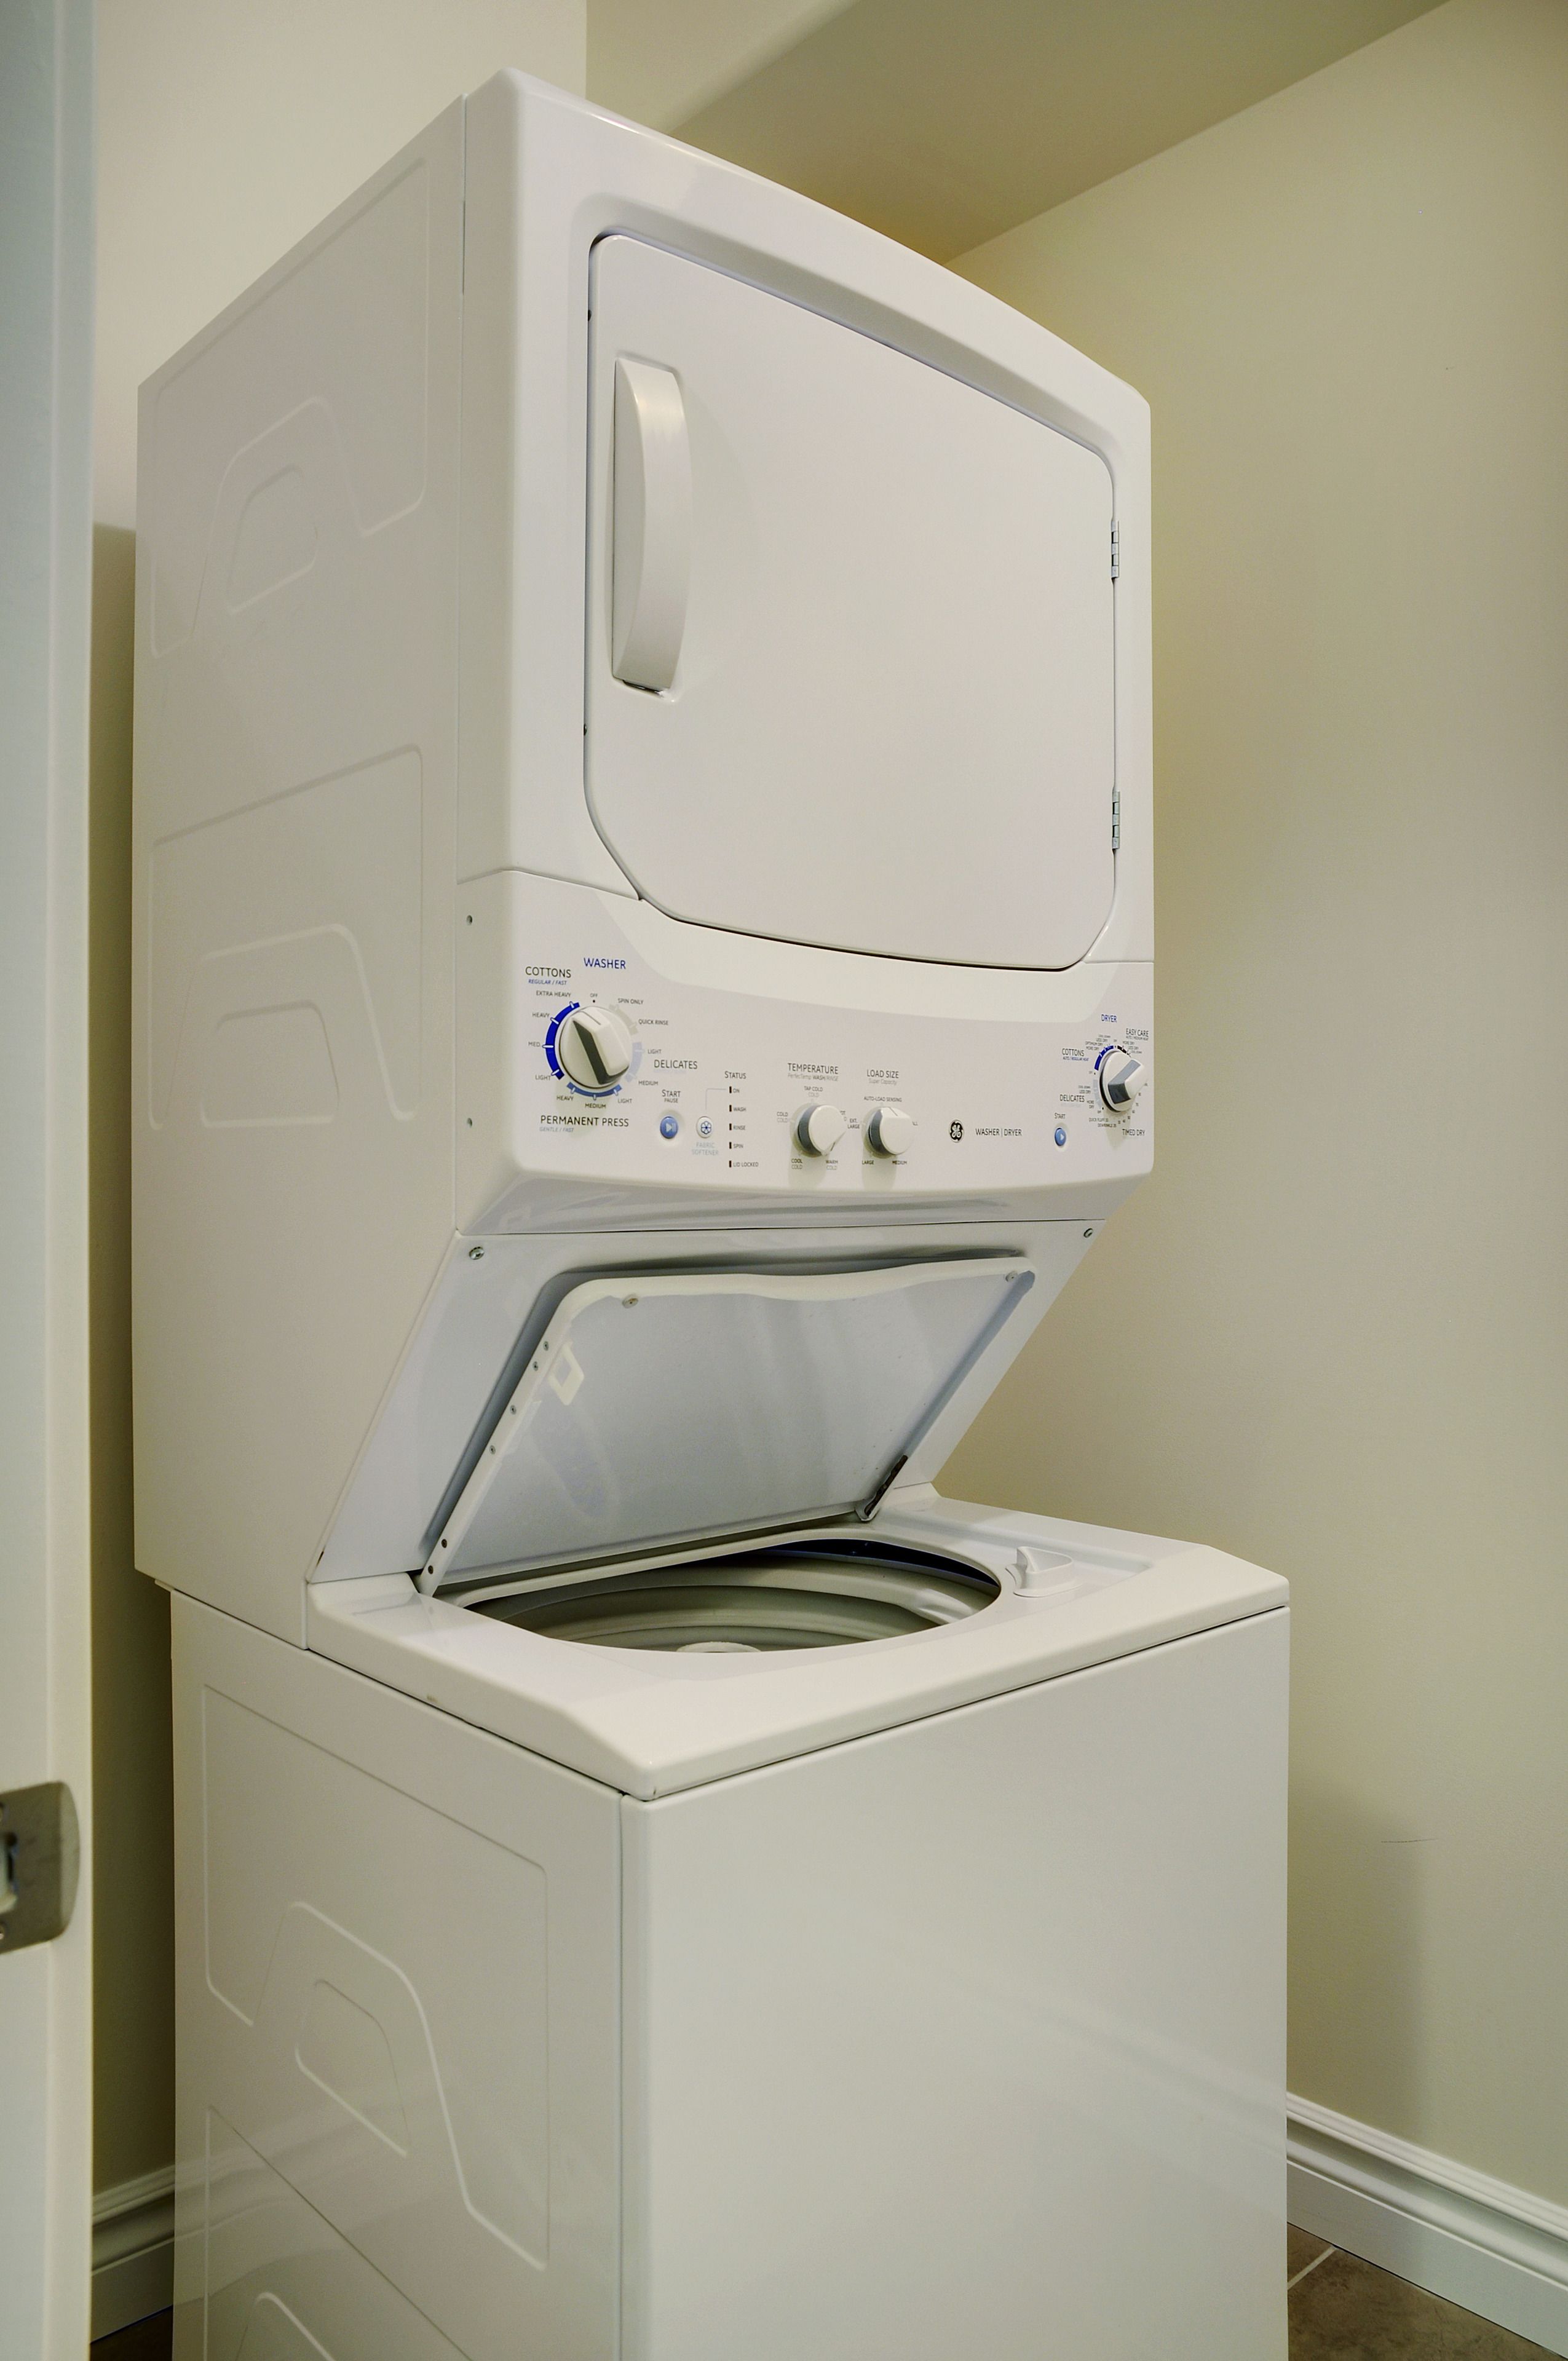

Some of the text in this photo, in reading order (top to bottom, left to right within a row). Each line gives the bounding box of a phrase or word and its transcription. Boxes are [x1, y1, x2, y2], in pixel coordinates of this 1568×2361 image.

[584, 957, 626, 970] WASHER
[525, 966, 571, 978] COTTONS
[1101, 1014, 1117, 1022] DRYER
[1062, 1048, 1084, 1057] COTTONS
[654, 1059, 698, 1069] DELICATES
[788, 1062, 839, 1074] TEMPERATURE
[724, 1070, 746, 1079] STATUS
[867, 1069, 884, 1078] LOAD
[662, 1089, 681, 1097] START
[540, 1115, 629, 1127] PERMANENT PRESS
